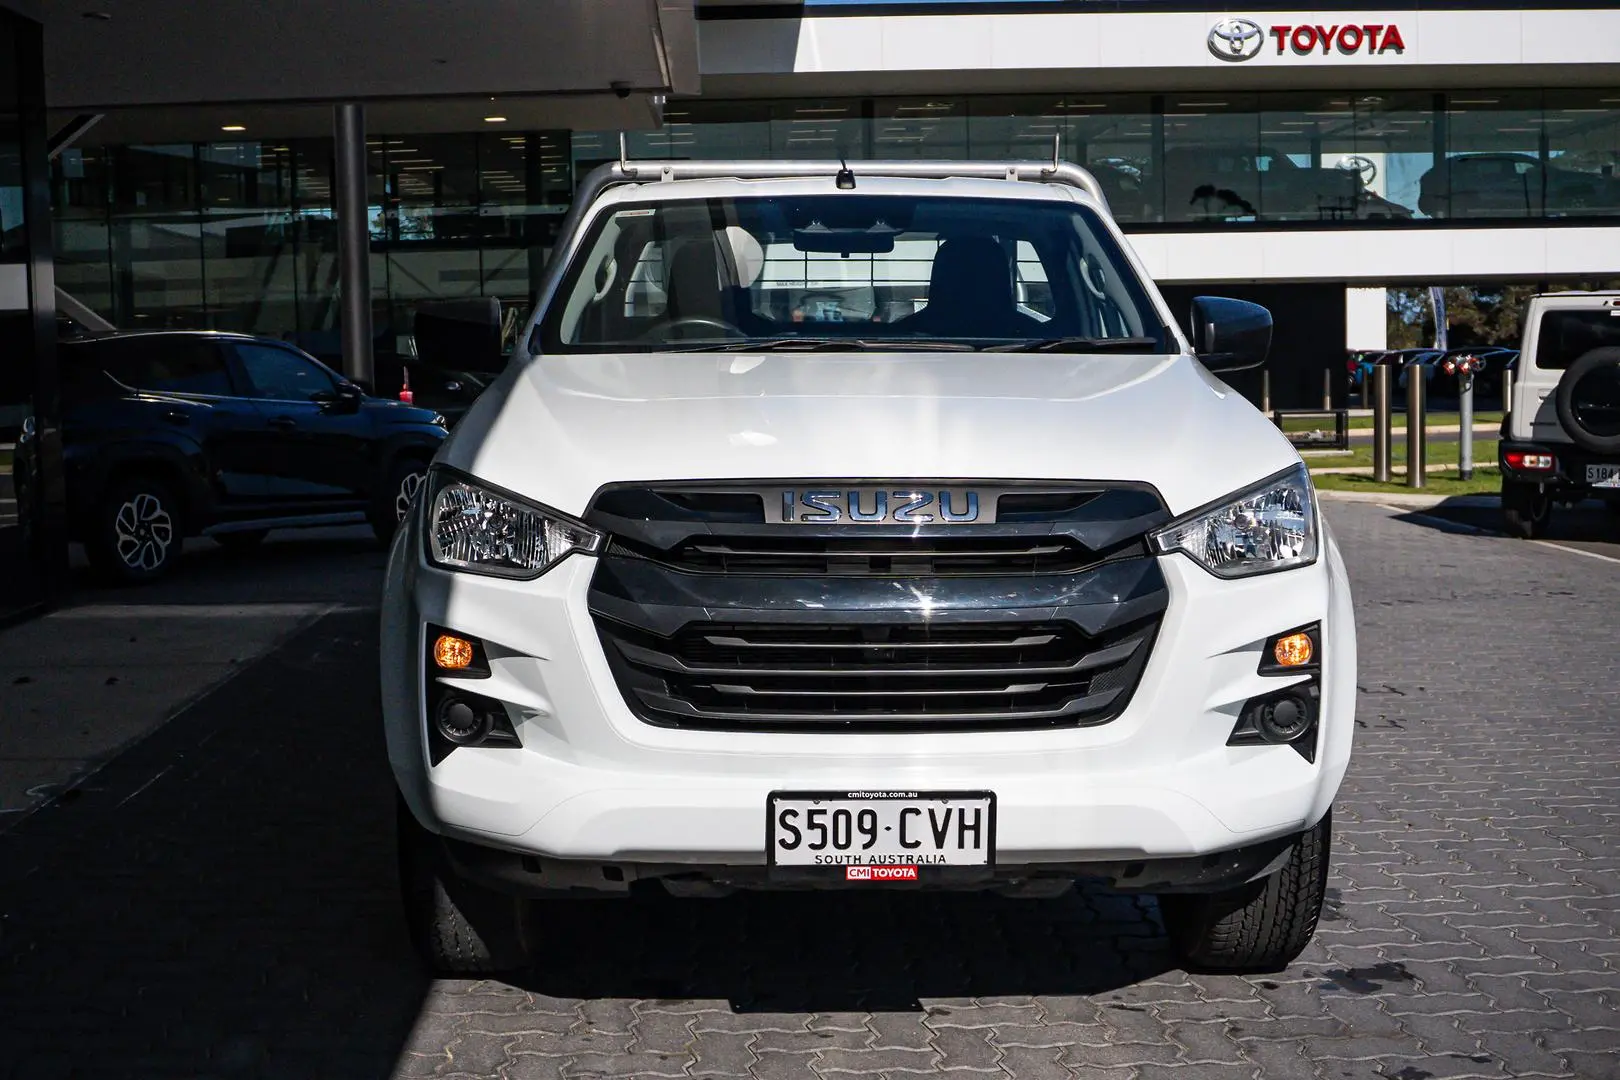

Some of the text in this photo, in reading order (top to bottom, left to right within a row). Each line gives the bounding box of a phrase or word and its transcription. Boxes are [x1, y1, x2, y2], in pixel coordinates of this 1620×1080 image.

[1270, 24, 1405, 52] TOYOTA
[782, 491, 979, 523] ISUZU
[847, 790, 918, 799] cmitoyota.com.au
[815, 854, 947, 864] SOUTH AUSTRALIA
[849, 868, 916, 878] CMI TOYOTA
